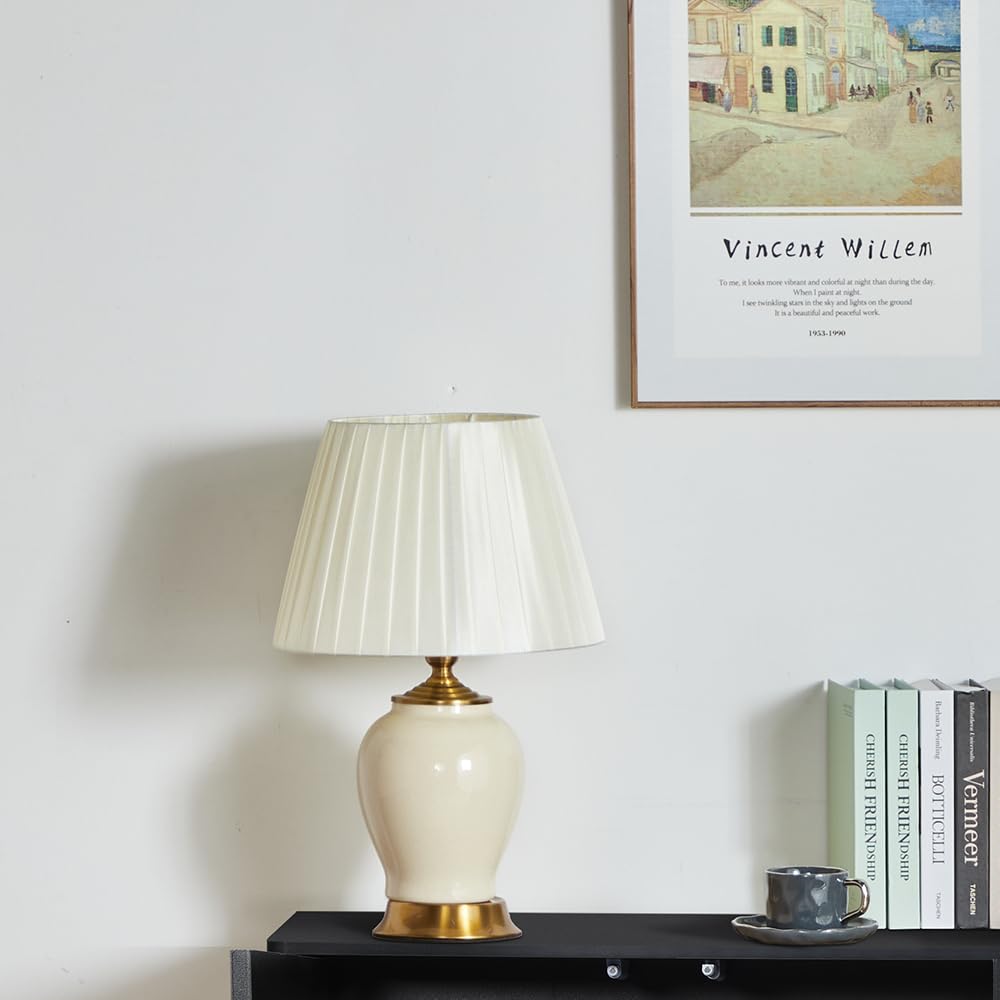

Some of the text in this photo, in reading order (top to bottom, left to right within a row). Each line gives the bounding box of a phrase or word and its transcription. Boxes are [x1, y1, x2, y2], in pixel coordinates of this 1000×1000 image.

[723, 237, 933, 260] Vincent Willem
[855, 279, 871, 287] night
[824, 299, 834, 307] sky
[850, 299, 867, 307] lights
[890, 299, 913, 307] ground
[864, 734, 877, 881] CHERISH FRIENDSHIP
[898, 734, 910, 881] CHERISH FRIENDSHIP
[932, 775, 945, 864] BOTTICELLI
[963, 770, 985, 867] Vermeer
